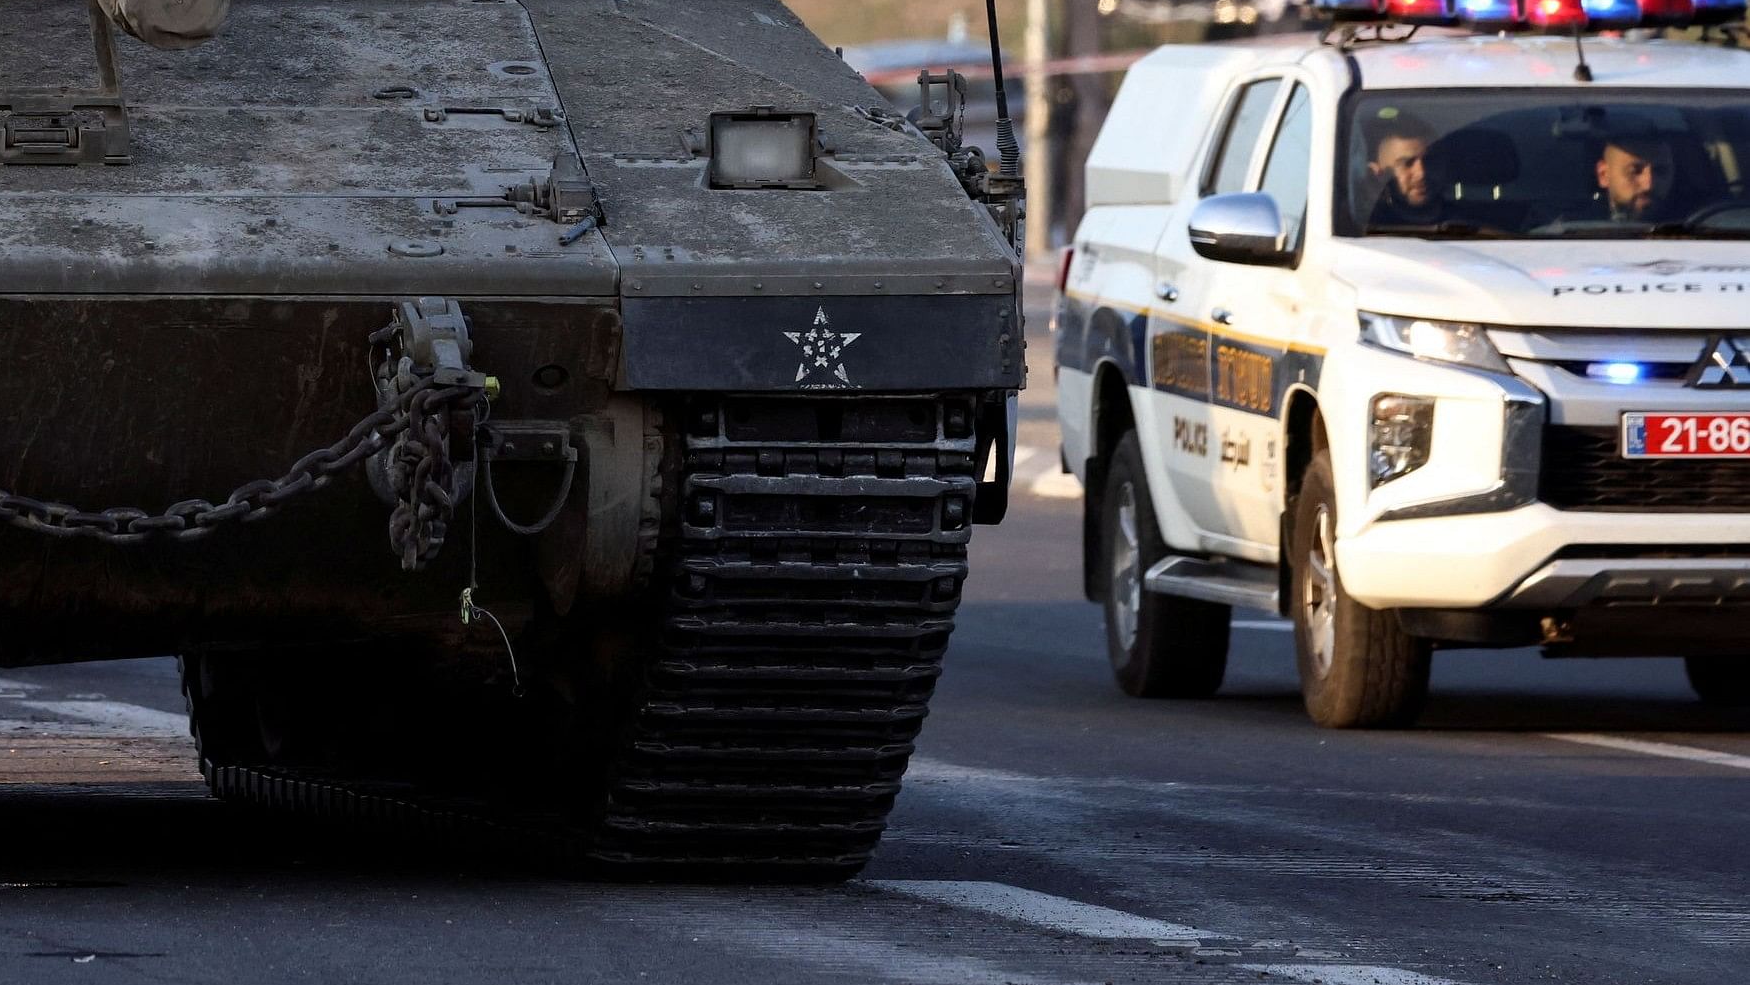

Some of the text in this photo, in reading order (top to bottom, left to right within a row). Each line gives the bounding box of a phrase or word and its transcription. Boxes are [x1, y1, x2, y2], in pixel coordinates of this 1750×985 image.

[1553, 282, 1702, 297] POLICE
[1174, 415, 1207, 457] POLICE
[1660, 417, 1750, 453] 21-86
